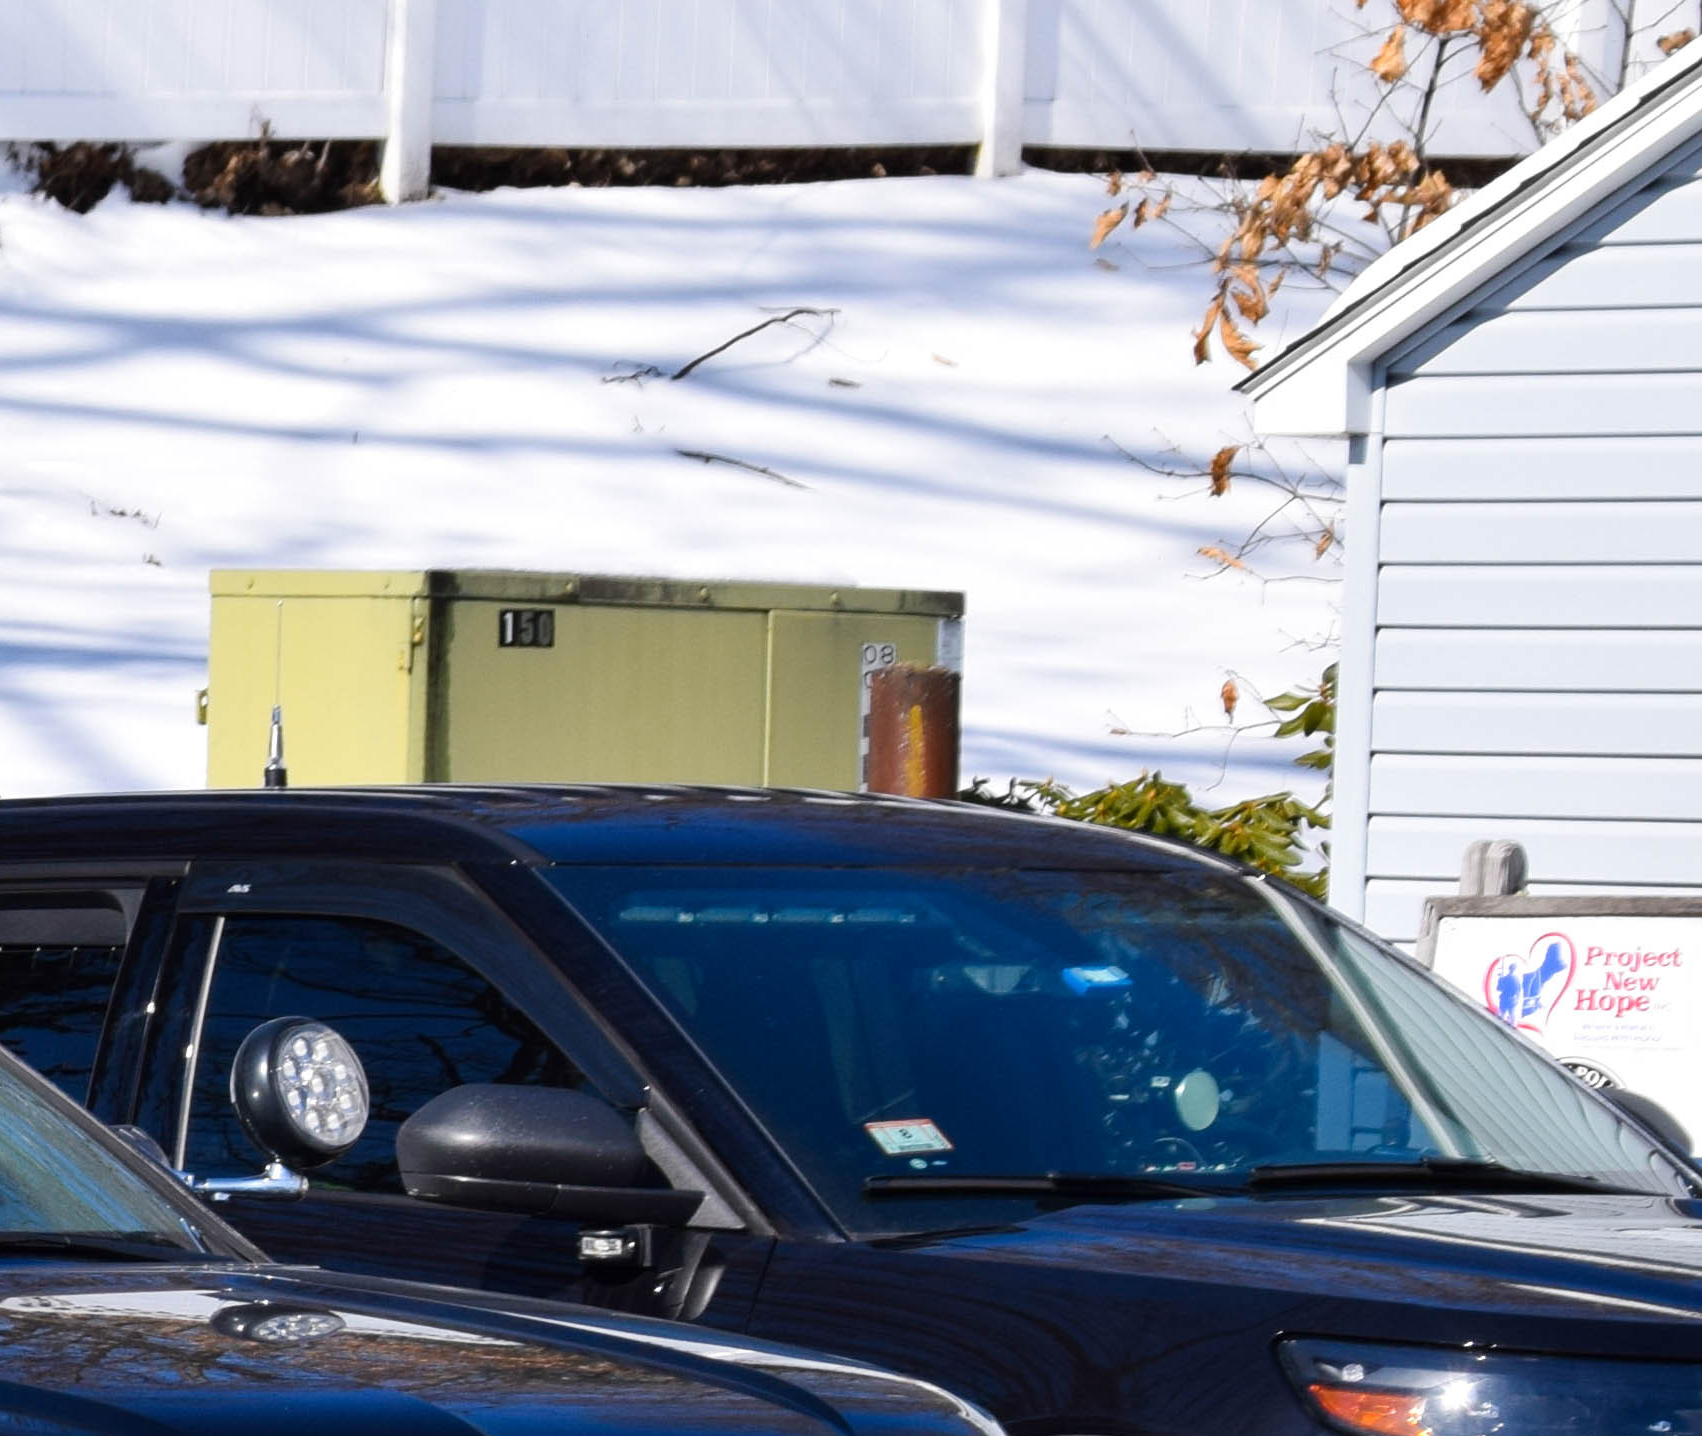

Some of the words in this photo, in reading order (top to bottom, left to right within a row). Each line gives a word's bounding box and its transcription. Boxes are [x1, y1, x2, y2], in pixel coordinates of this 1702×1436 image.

[504, 612, 551, 645] 150
[863, 645, 895, 665] 08
[1583, 946, 1683, 973] Project
[1603, 972, 1661, 991] New
[1573, 989, 1651, 1018] Hope
